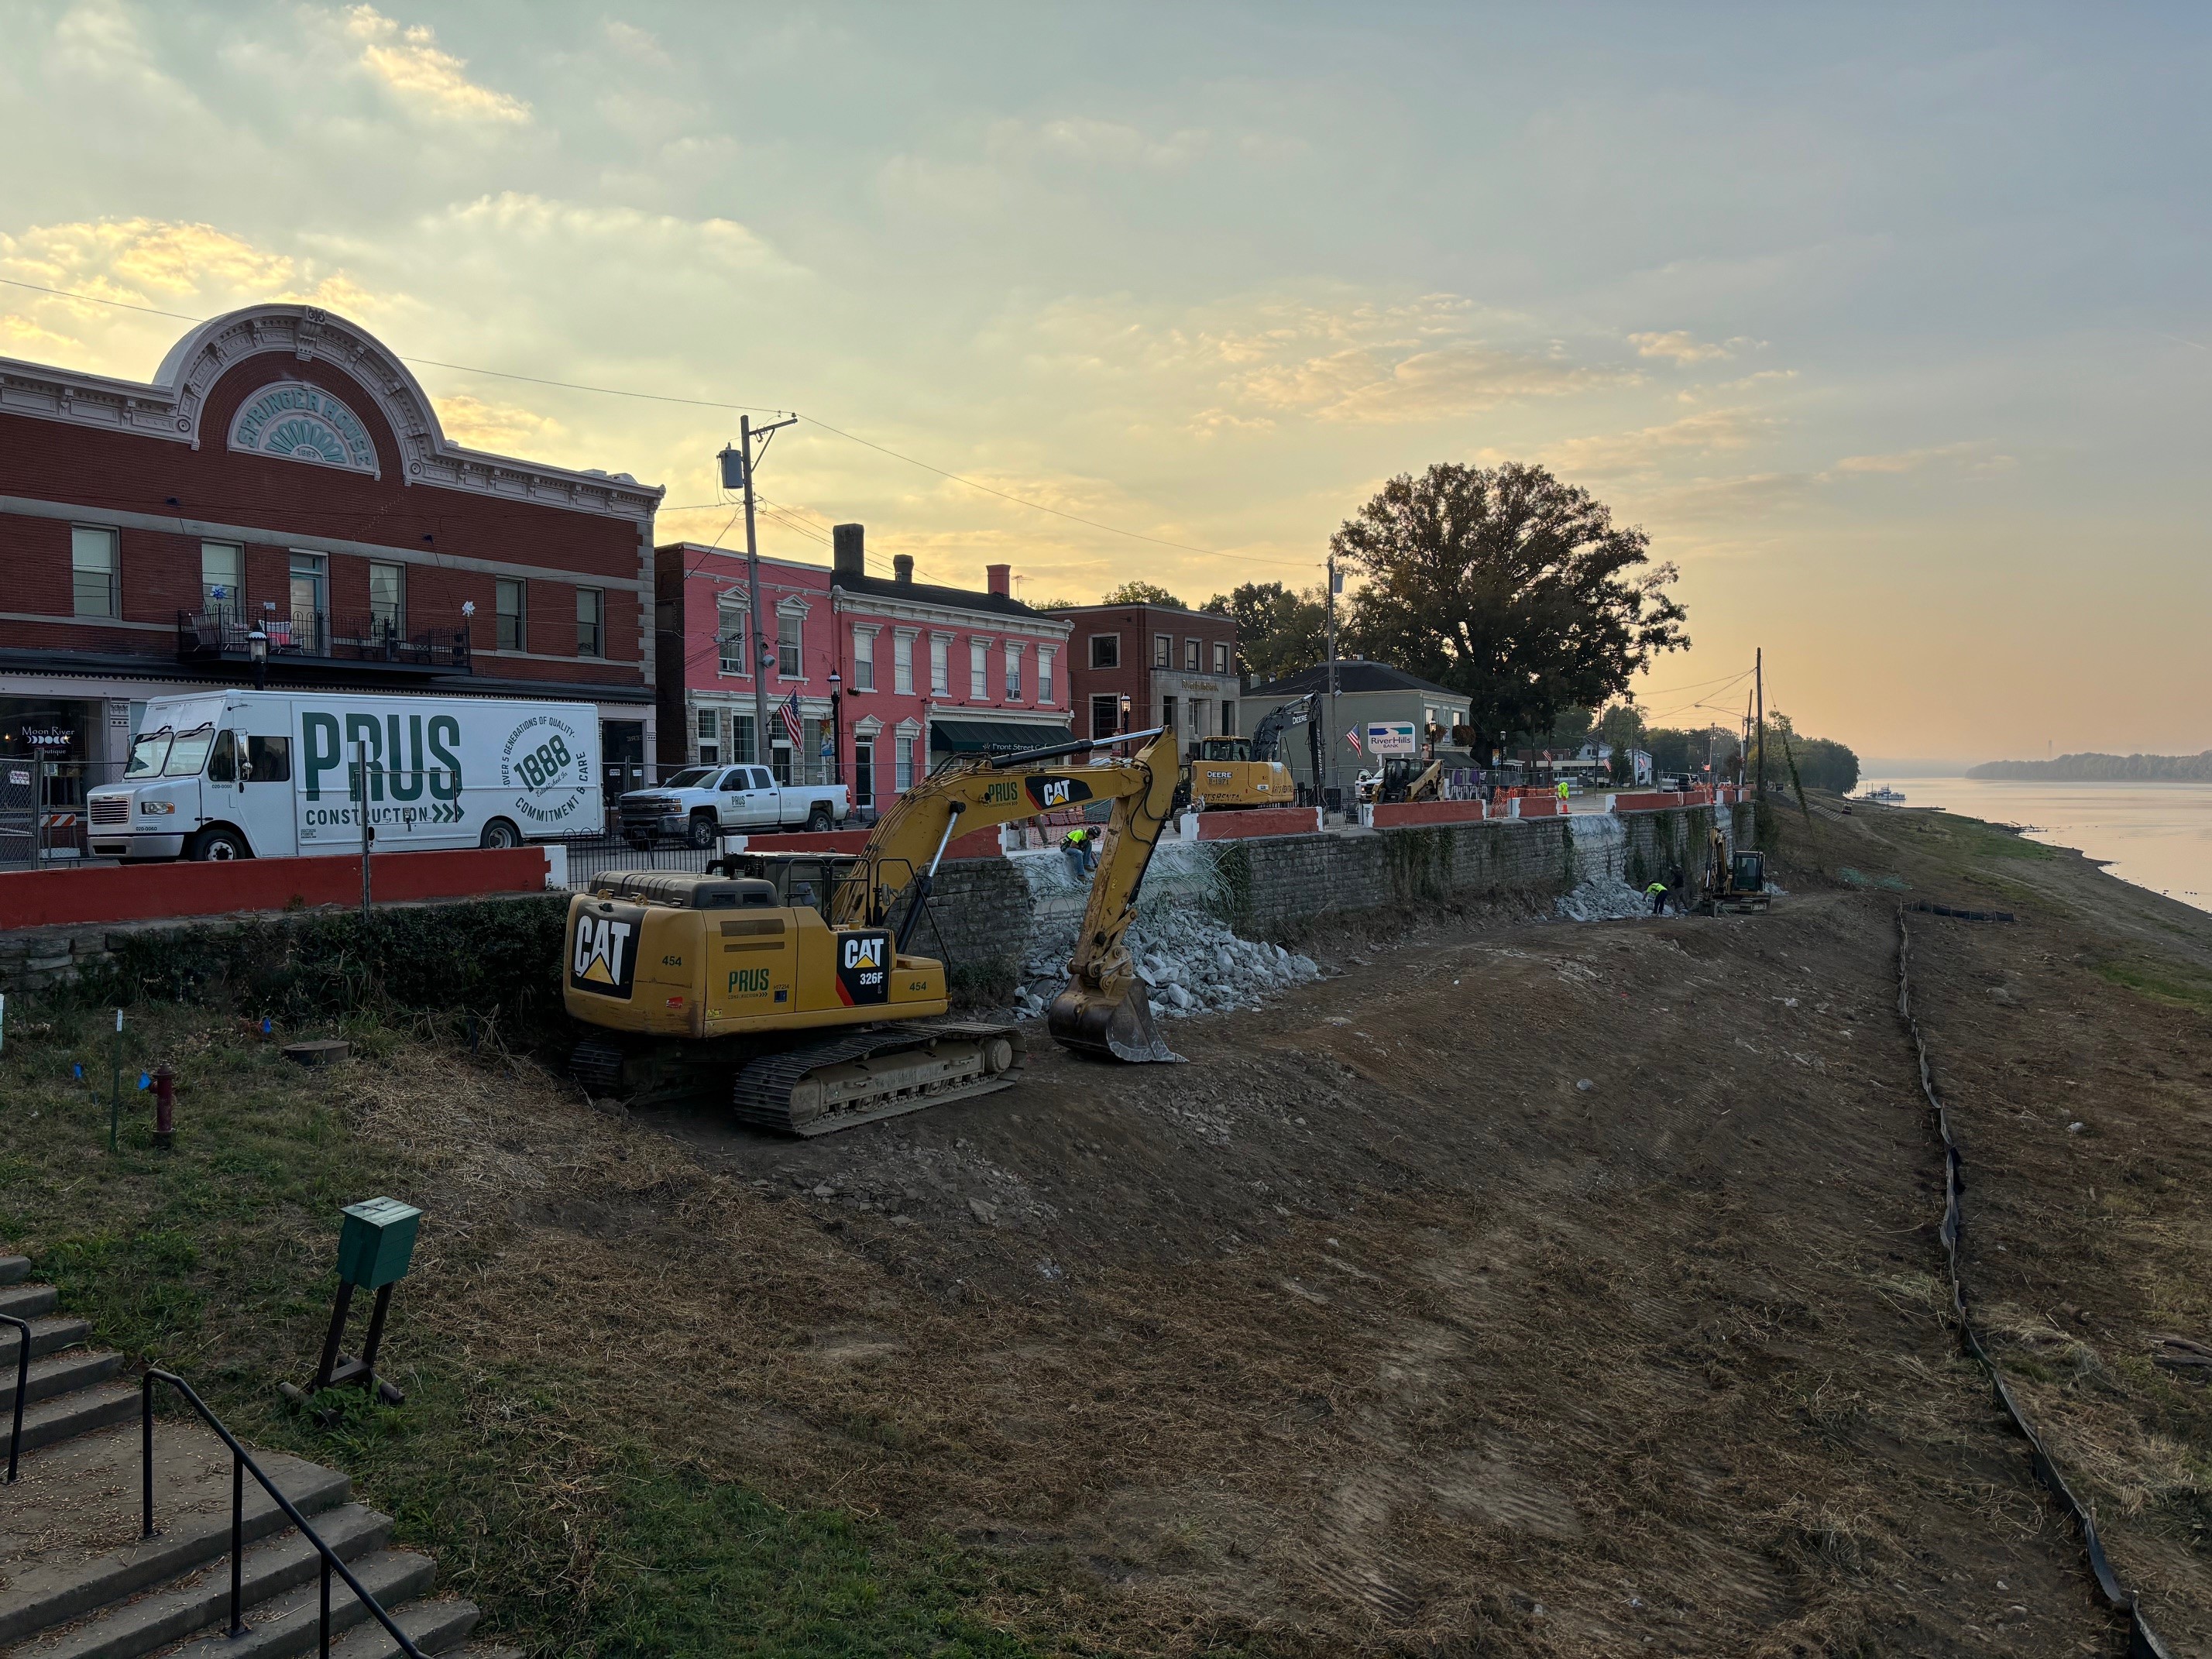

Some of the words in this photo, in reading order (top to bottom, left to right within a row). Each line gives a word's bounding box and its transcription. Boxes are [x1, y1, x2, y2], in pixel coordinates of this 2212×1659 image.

[238, 389, 320, 448] SPRINGER
[321, 399, 372, 465] HOUSE
[539, 716, 547, 725] OF
[549, 717, 575, 737] QUALITY
[1292, 714, 1308, 724] DEERE
[22, 726, 49, 736] Moon
[51, 726, 75, 736] River
[503, 717, 538, 755] GENERATIONS
[1371, 736, 1411, 744] RiverHills
[302, 712, 462, 802] PRUS
[514, 734, 571, 792] 1888
[576, 751, 588, 781] CARE
[501, 764, 510, 786] OVER
[535, 775, 562, 797] Established
[576, 786, 586, 795] &
[731, 795, 746, 805] PRUS
[988, 781, 1018, 802] PRUS
[1043, 779, 1070, 806] CAT
[515, 795, 579, 822] COMMITMENT
[574, 915, 631, 986] CAT
[661, 955, 682, 967] 454
[844, 938, 884, 969] CAT
[728, 968, 770, 993] PRUS
[860, 971, 883, 985] 326F
[909, 981, 927, 991] 454
